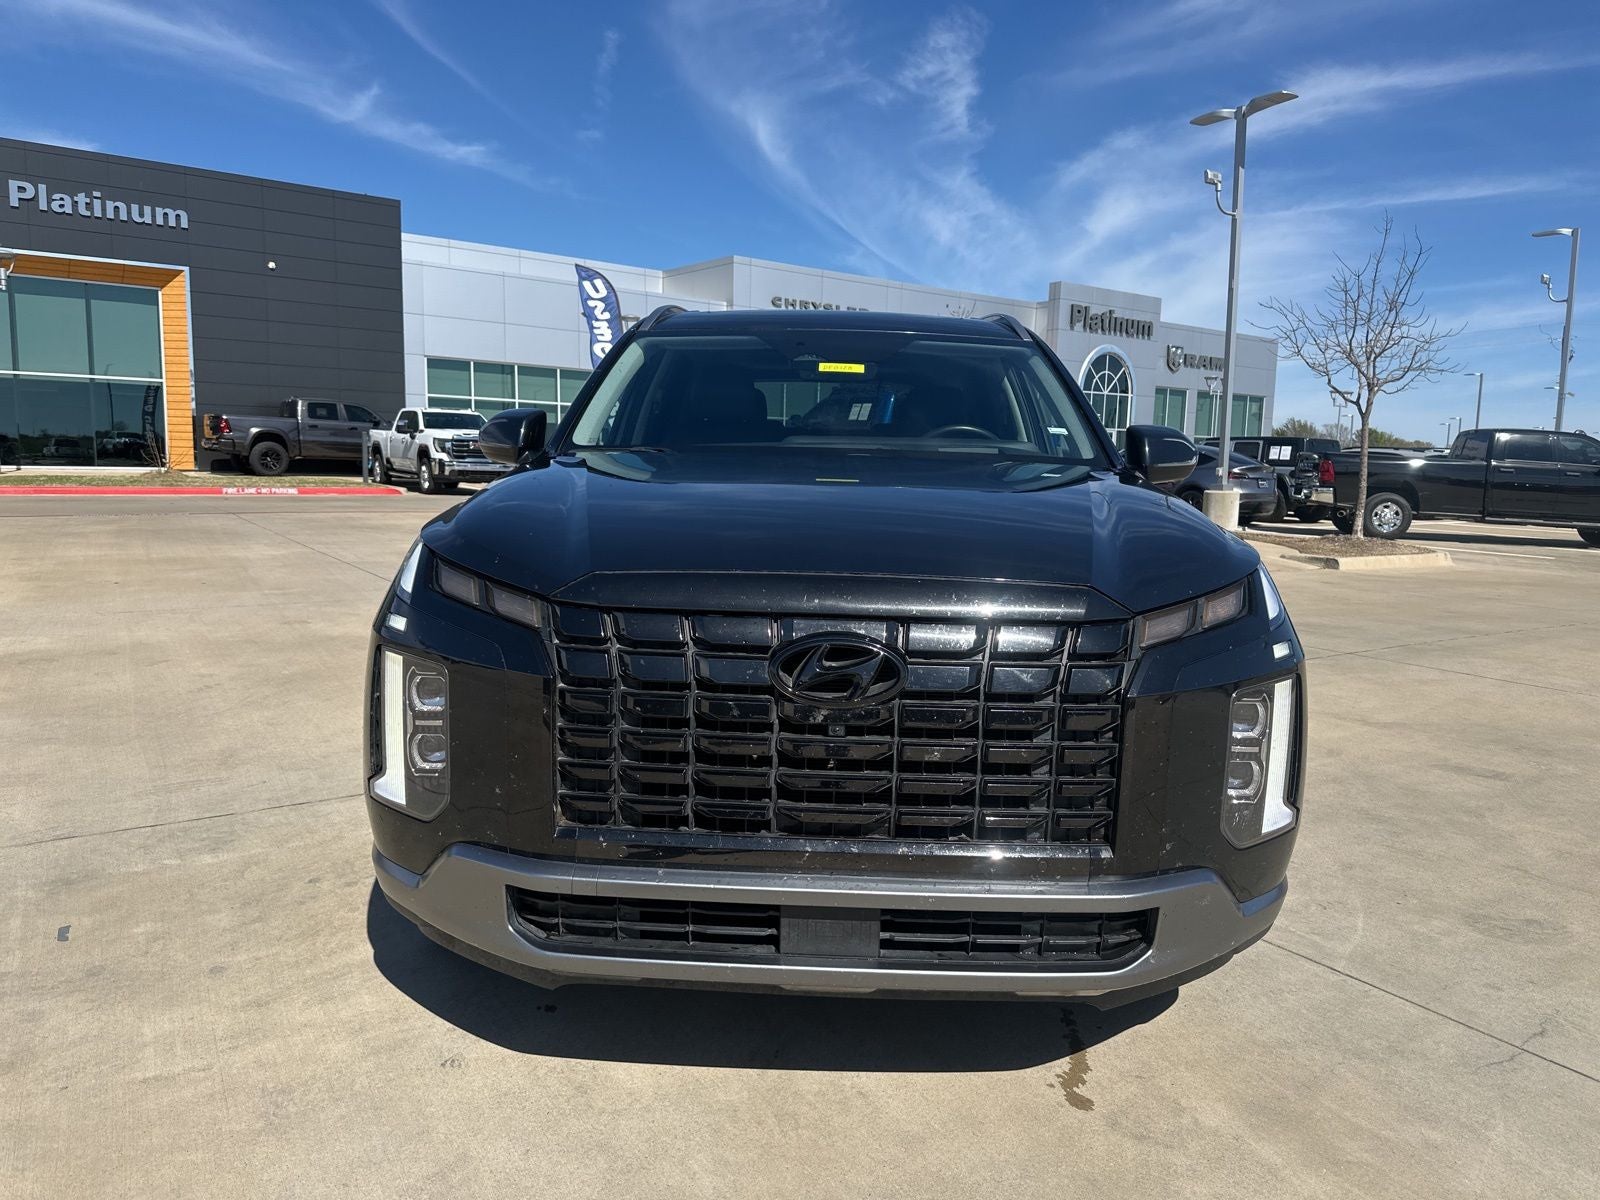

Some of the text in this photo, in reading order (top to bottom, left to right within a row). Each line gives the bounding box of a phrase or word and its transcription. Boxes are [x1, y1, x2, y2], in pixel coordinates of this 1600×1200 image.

[8, 179, 189, 230] Platinum
[771, 296, 870, 311] CHRYS
[1069, 303, 1154, 340] Platinum
[1184, 353, 1225, 372] RAM
[222, 487, 238, 495] FIRE
[271, 487, 299, 495] PARKING
